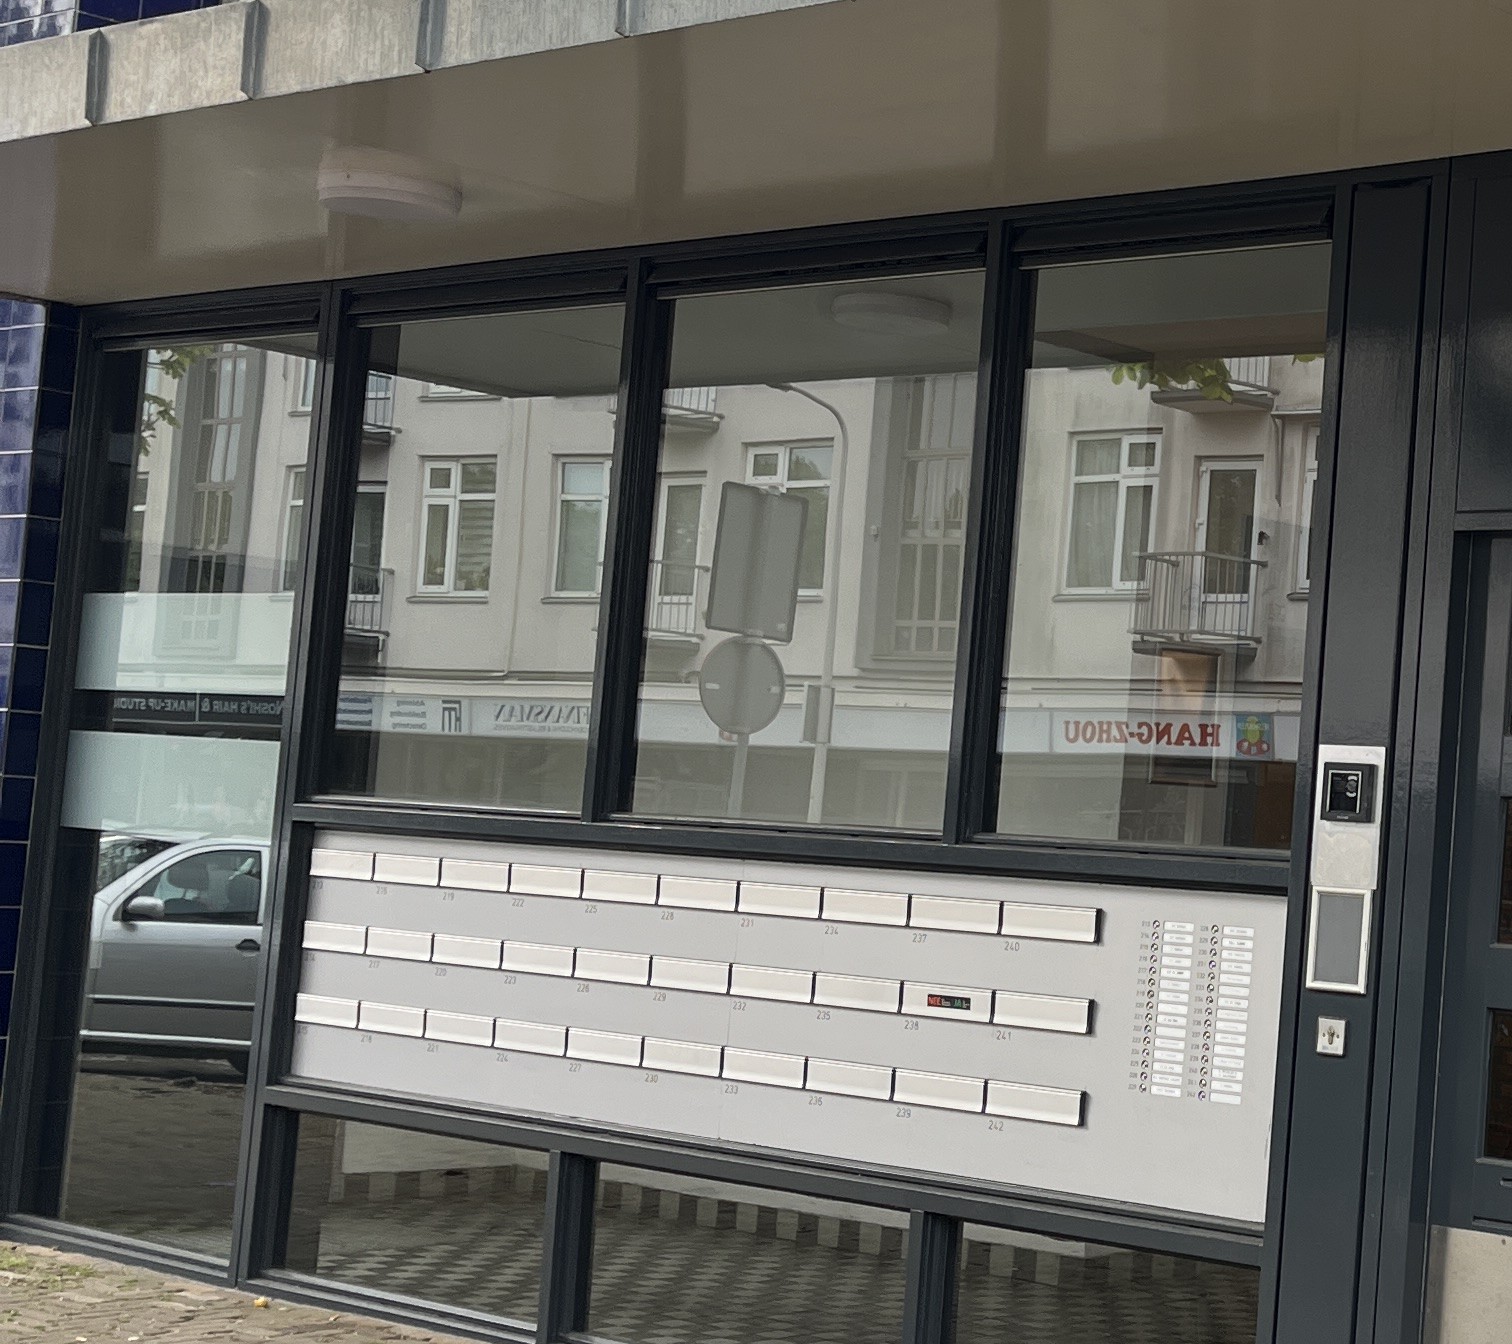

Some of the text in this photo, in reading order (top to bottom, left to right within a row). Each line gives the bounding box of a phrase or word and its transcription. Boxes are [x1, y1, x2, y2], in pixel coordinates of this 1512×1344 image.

[443, 892, 454, 901] 219
[512, 898, 524, 907] 222
[584, 905, 597, 914] 225
[661, 911, 674, 920] 228
[741, 918, 753, 927] 231
[825, 925, 838, 935] 234
[912, 933, 927, 943] 237
[1004, 941, 1020, 951] 240
[504, 975, 516, 984] 223
[577, 983, 589, 993] 226
[653, 992, 666, 1001] 229
[733, 1001, 746, 1011] 232
[817, 1010, 830, 1020] 235
[904, 1020, 919, 1030] 238
[996, 1031, 1011, 1041] 241
[569, 1063, 582, 1072] 227
[645, 1073, 658, 1083] 230
[724, 1084, 738, 1095] 233
[808, 1095, 822, 1106] 236
[896, 1106, 911, 1118] 239
[988, 1120, 1003, 1131] 242
